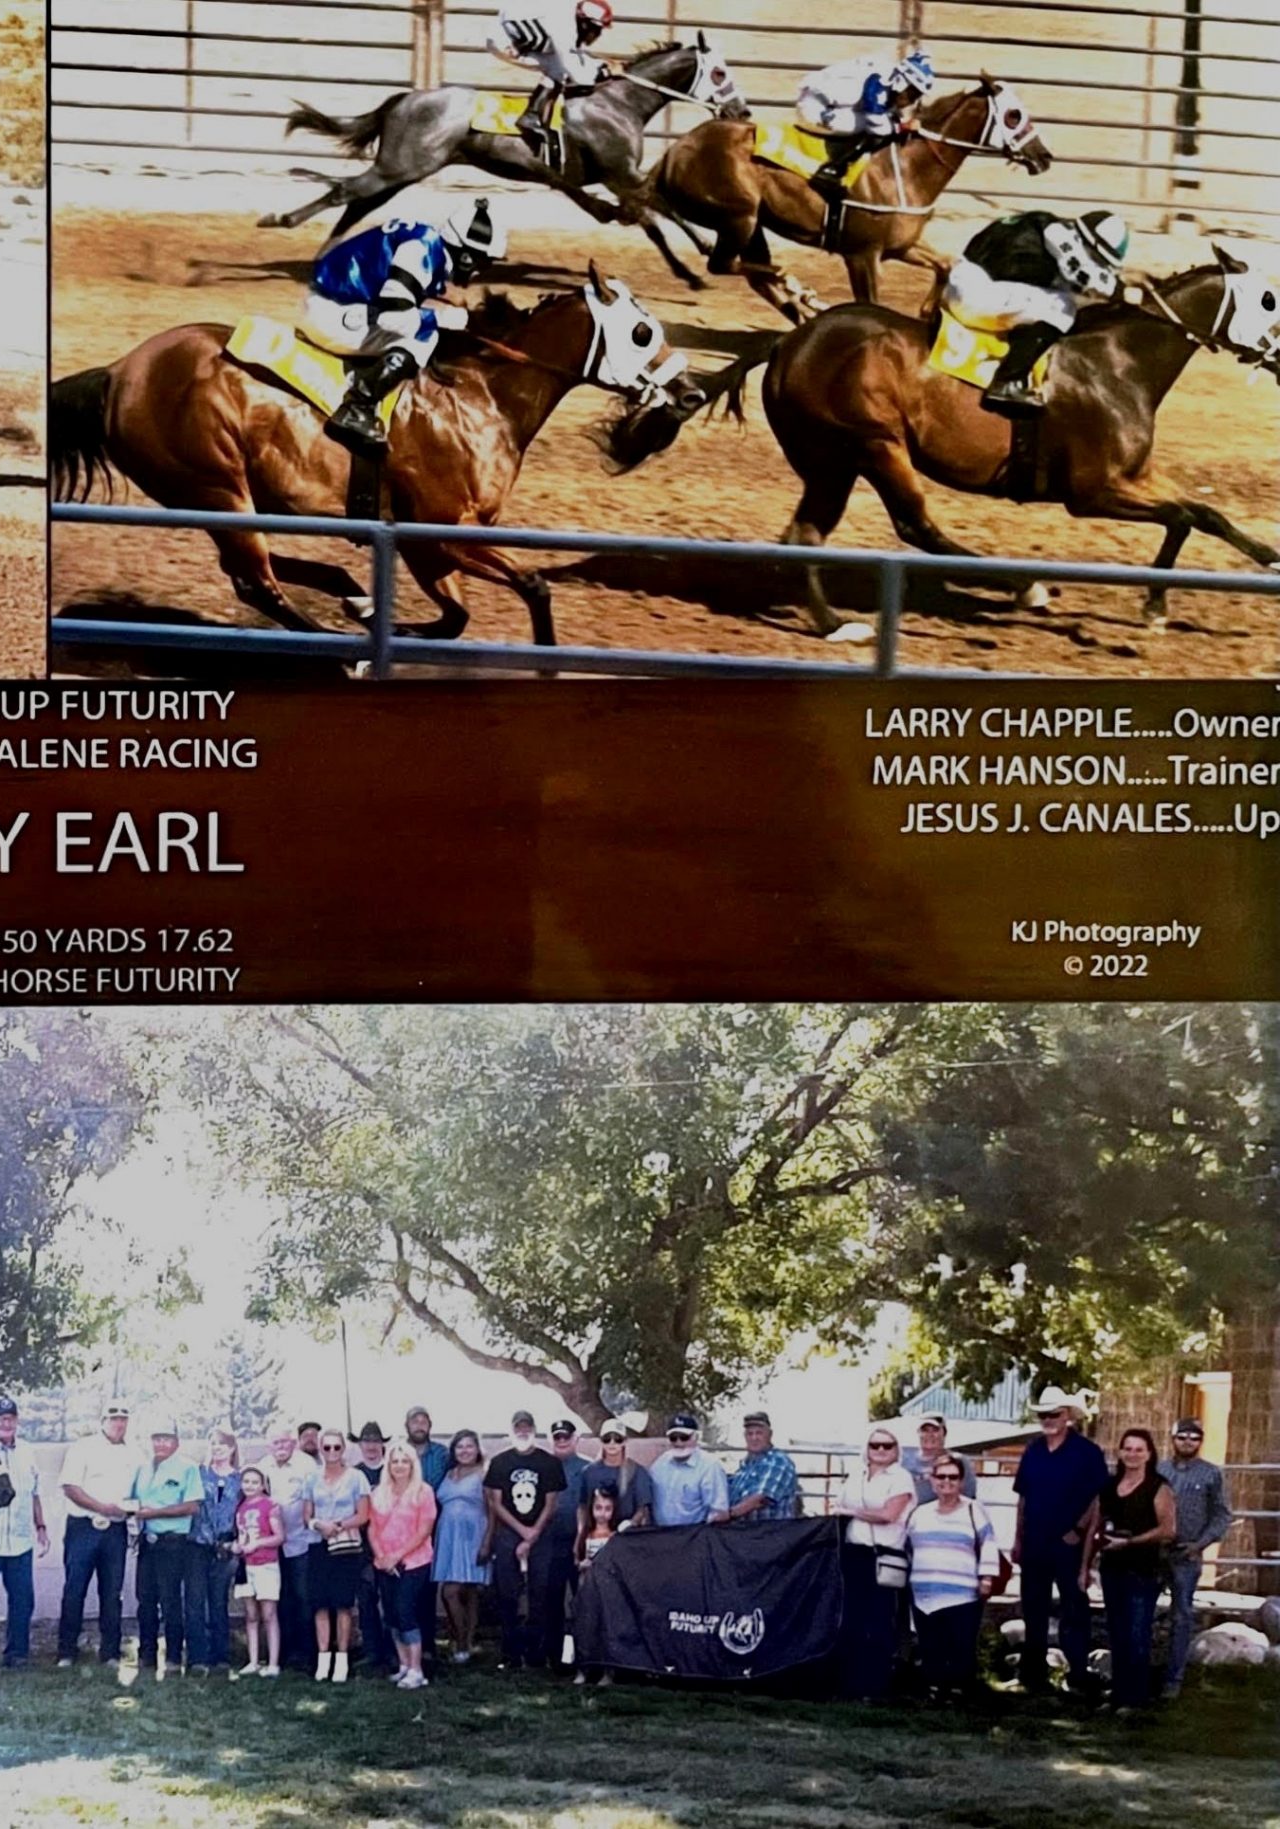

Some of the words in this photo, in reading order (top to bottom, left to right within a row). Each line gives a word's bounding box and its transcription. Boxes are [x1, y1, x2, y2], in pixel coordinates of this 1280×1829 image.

[62, 690, 235, 720] FUTURITY
[865, 708, 972, 738] LARRY
[120, 738, 258, 768] RACING
[872, 755, 971, 785] MARK
[900, 803, 999, 833] JESUS
[1006, 804, 1030, 833] J.
[55, 811, 245, 873] EARL
[45, 928, 147, 953] YARDS
[158, 928, 234, 953] 17.62
[1011, 921, 1038, 943] KJ
[1044, 919, 1202, 948] Photography
[97, 966, 241, 993] FUTURITY
[1090, 954, 1149, 977] 2022
[668, 1611, 702, 1624] IDAHO
